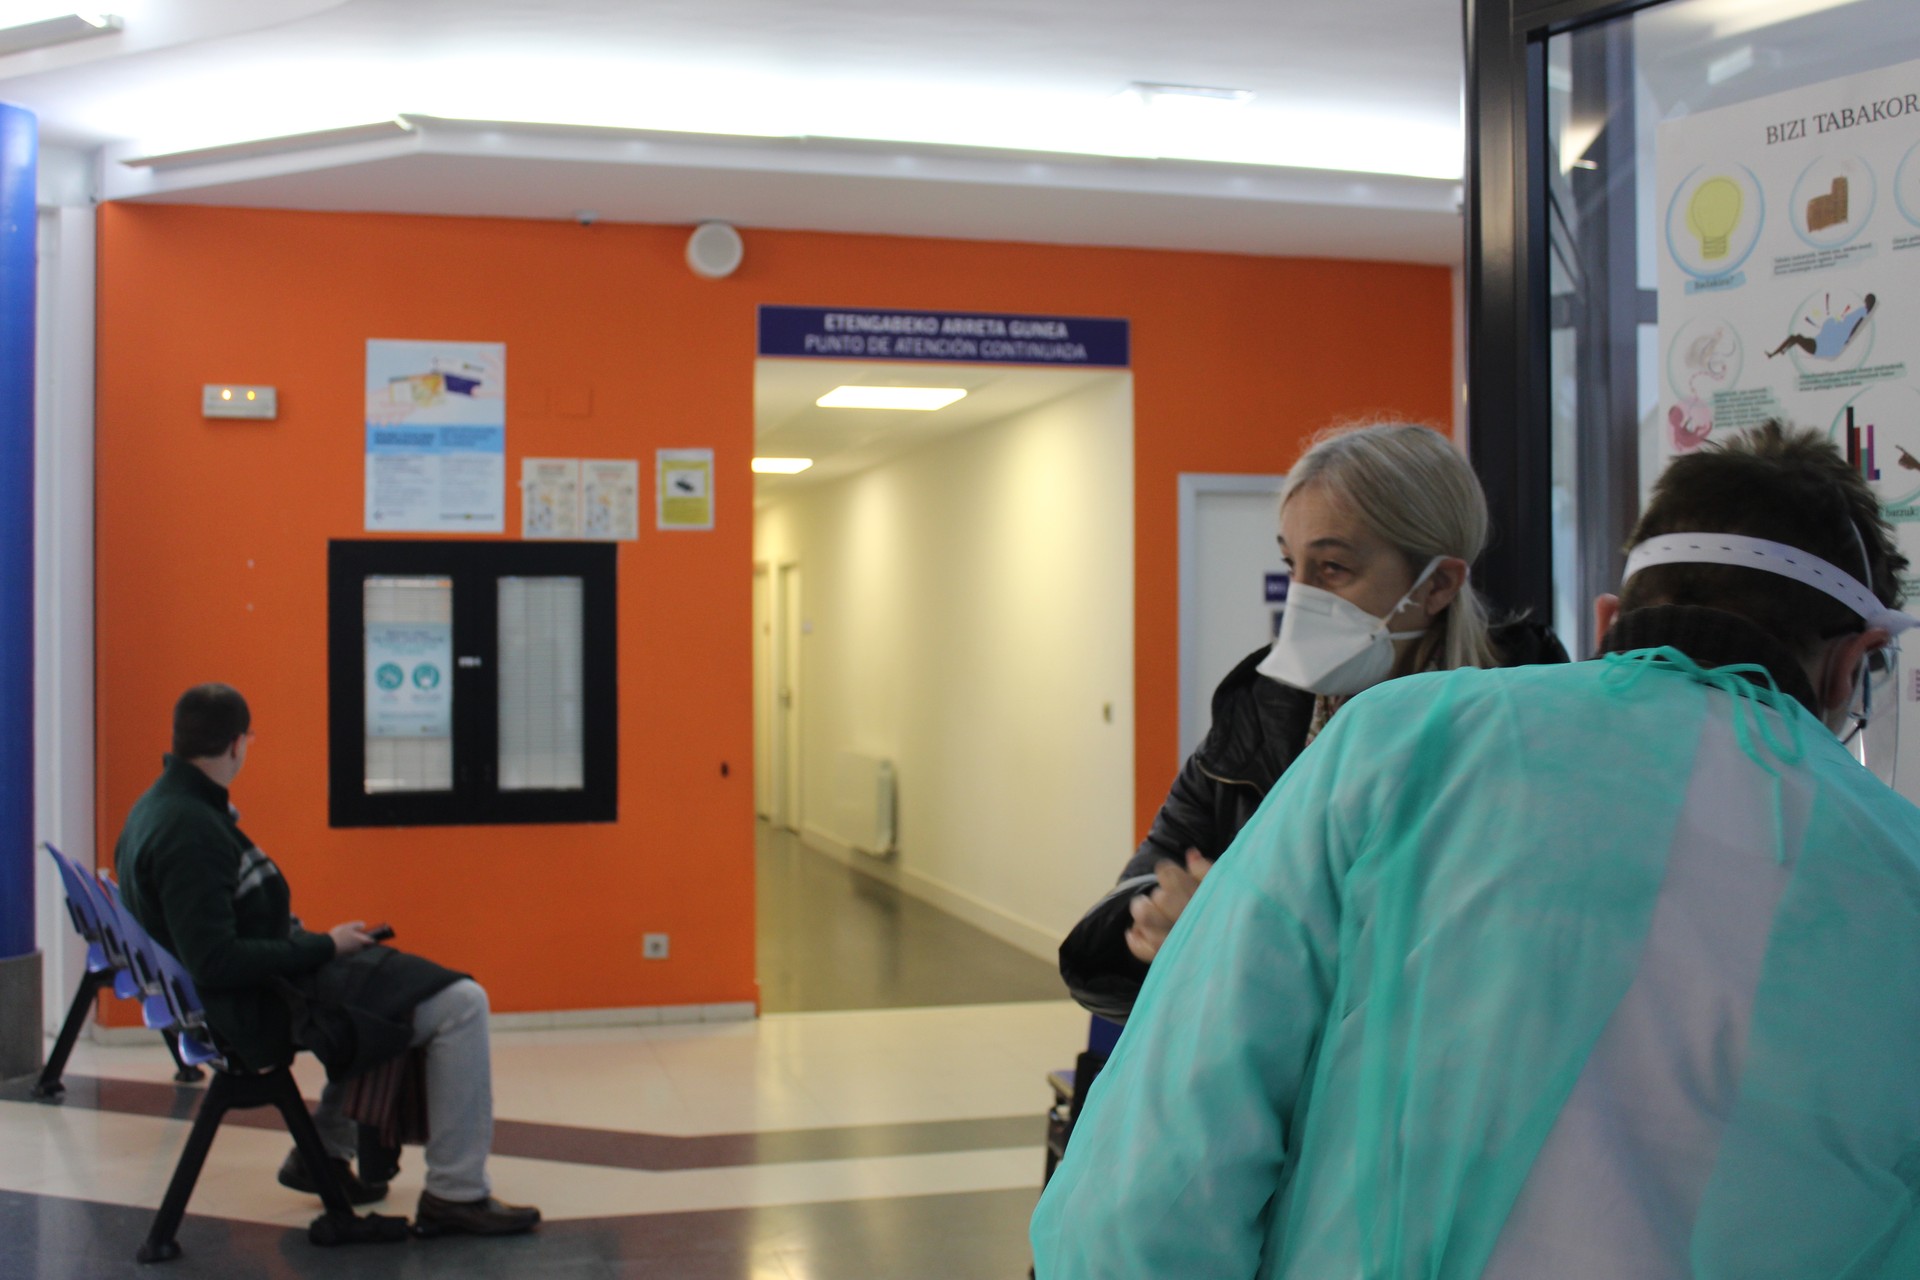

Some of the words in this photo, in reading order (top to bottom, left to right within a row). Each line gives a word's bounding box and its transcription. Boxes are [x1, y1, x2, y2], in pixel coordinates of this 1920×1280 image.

[1766, 118, 1806, 145] BIZI
[1813, 93, 1920, 134] TABAKOR
[823, 312, 939, 335] ETENGABEKO
[941, 316, 1006, 337] ARRETA
[1007, 319, 1070, 339] GUNEA
[804, 333, 865, 354] PUNTO
[866, 335, 892, 355] DE
[893, 336, 978, 358] ATENCIÓN
[979, 339, 1088, 360] CONTINUADA
